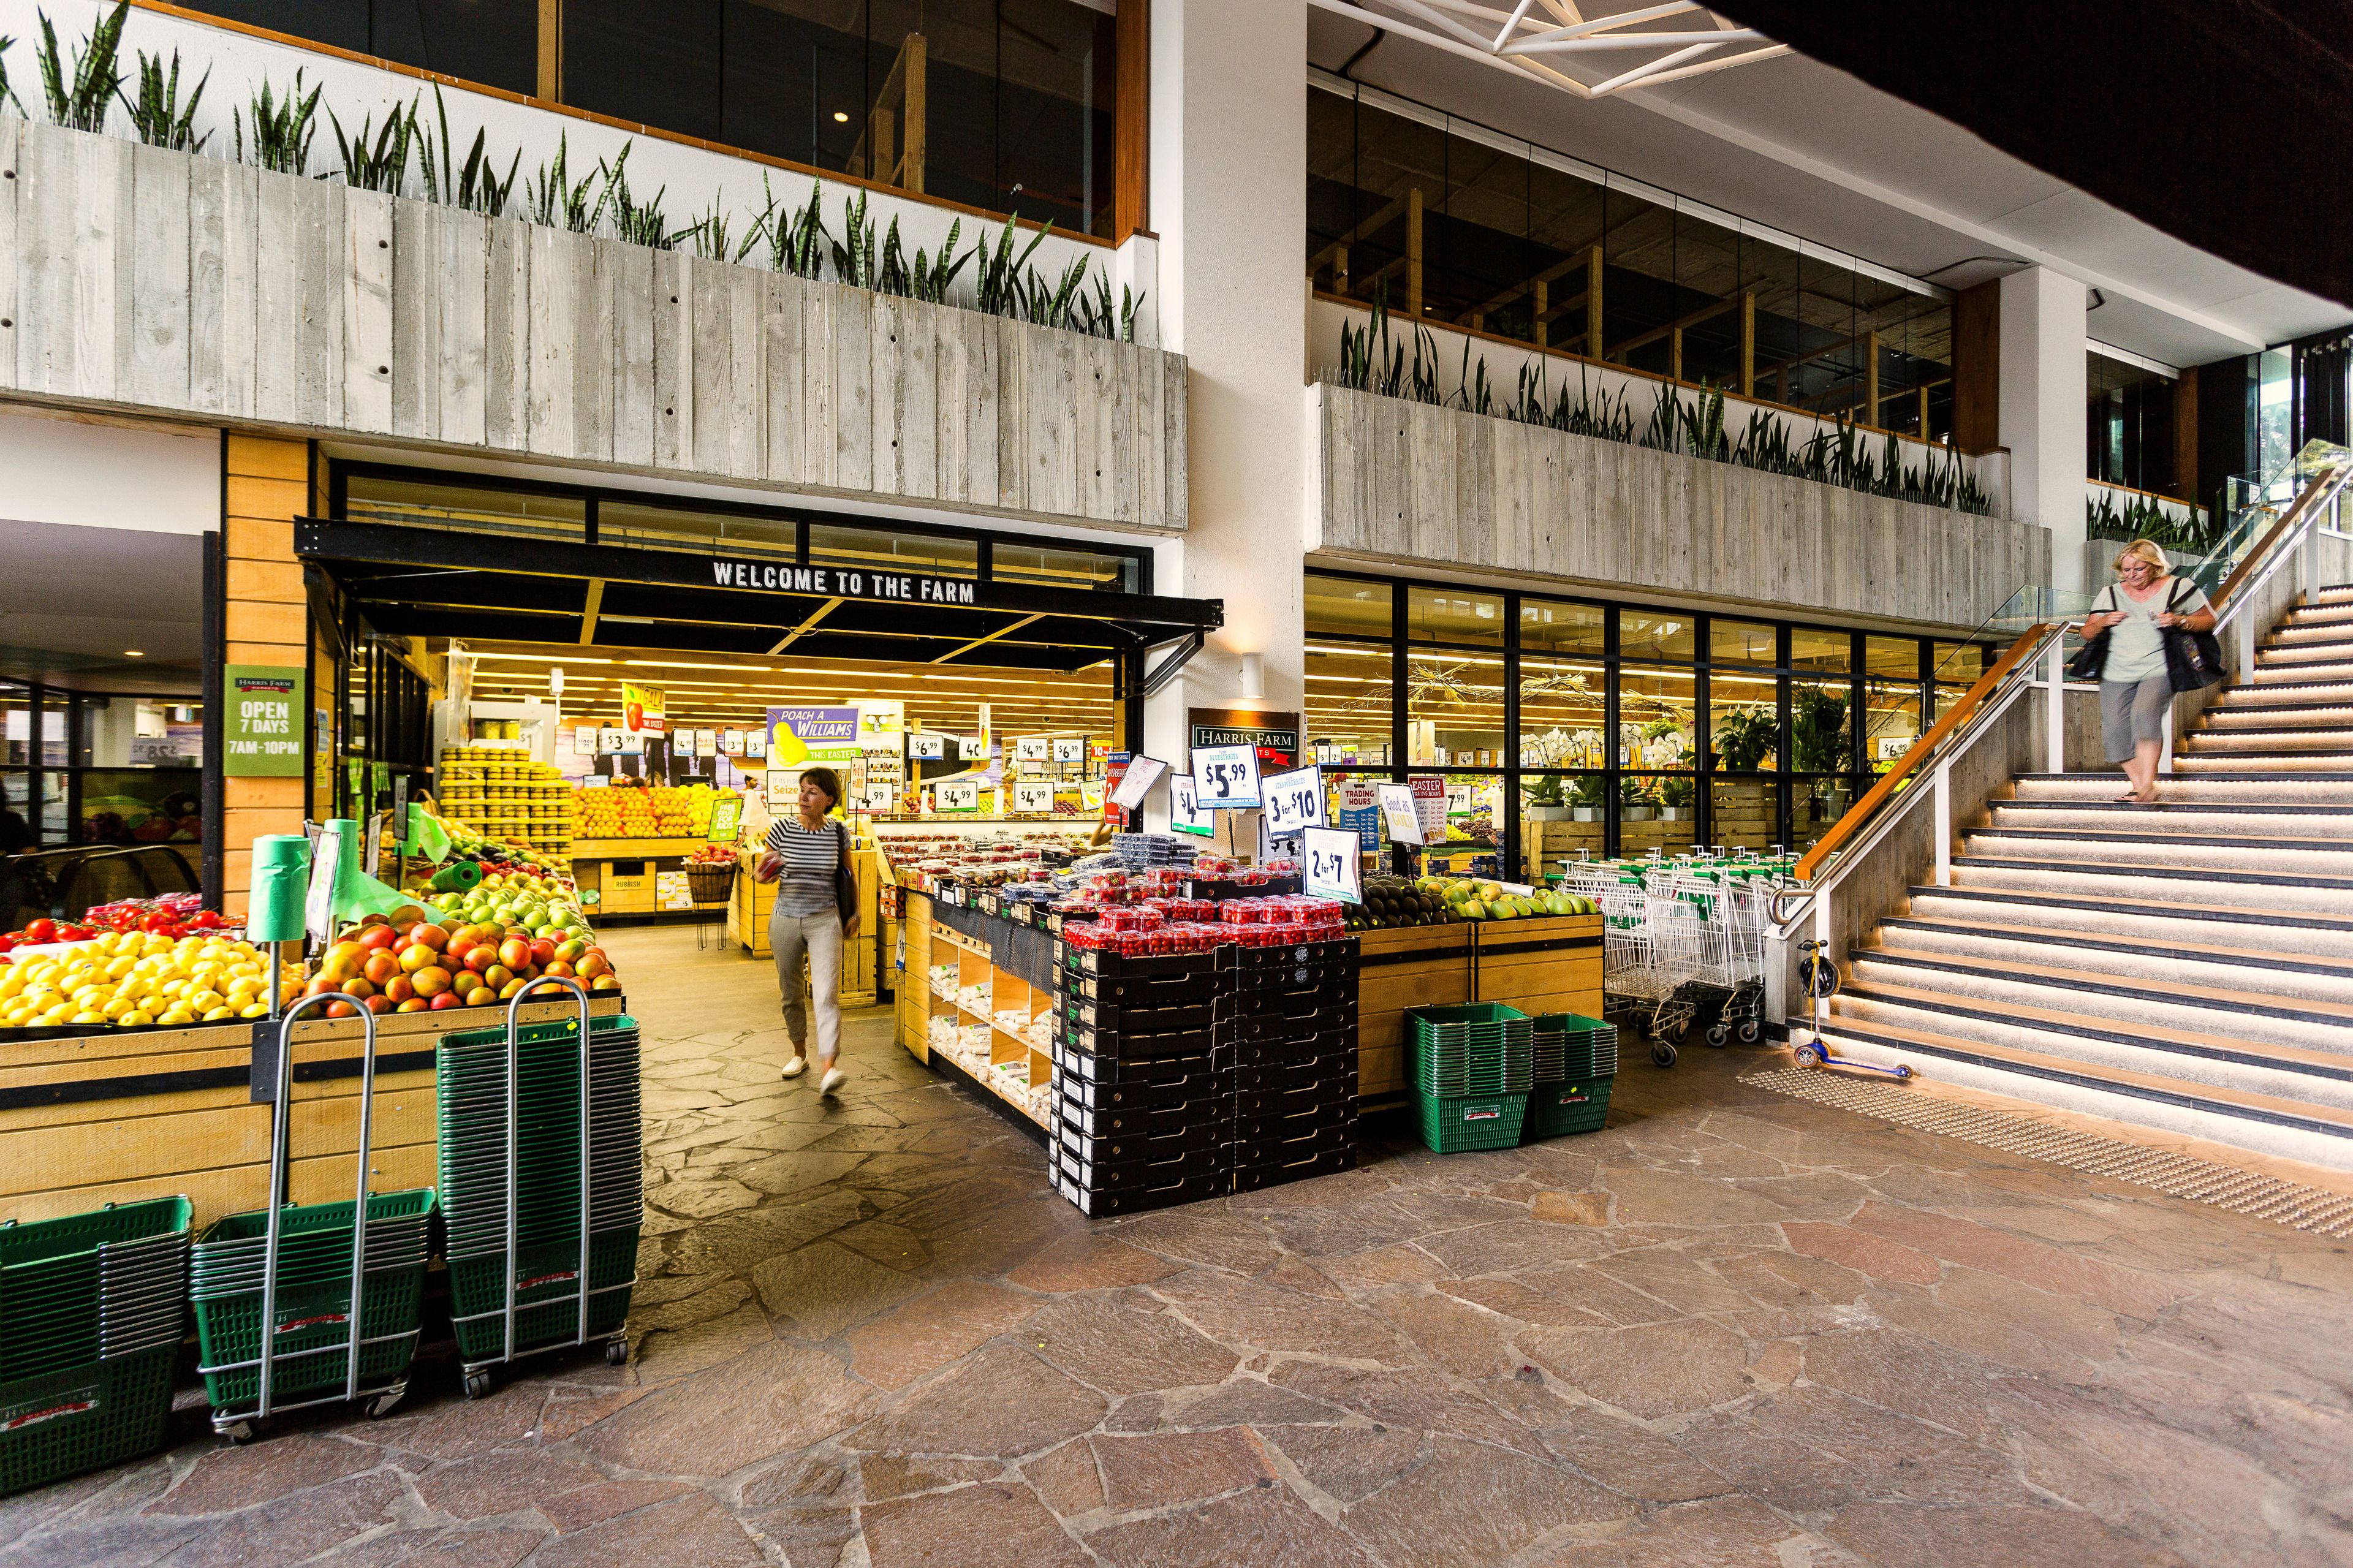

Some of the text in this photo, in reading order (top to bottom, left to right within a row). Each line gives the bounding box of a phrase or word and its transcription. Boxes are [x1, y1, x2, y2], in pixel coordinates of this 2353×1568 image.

[713, 562, 974, 603] WELCOME TO THE FARM
[643, 689, 662, 708] GALA
[241, 701, 289, 719] OPEN
[781, 710, 824, 721] POACH A
[240, 719, 289, 733] 7 DAYS
[798, 721, 853, 737] WILLIAMS
[608, 735, 635, 750] $3.99
[1200, 730, 1292, 746] HARRIS FARM
[229, 740, 299, 754] 7AM-10PM
[809, 749, 856, 759] THIS EASTER
[915, 741, 938, 756] $6.99
[1023, 744, 1042, 757] $4.99
[1059, 746, 1078, 759] $6.99
[1094, 746, 1103, 757] 10
[1885, 744, 1907, 757] $6.99
[1461, 756, 1471, 765] $4.99
[1206, 763, 1246, 798] $5.99
[1275, 778, 1306, 790] STRAWBERRIES
[1412, 780, 1441, 791] EASTER
[774, 785, 798, 794] Seize
[944, 790, 971, 807] $4.99
[1021, 790, 1045, 806] $4.99
[1271, 789, 1315, 822] 3 for $10
[1385, 795, 1410, 812] Good as
[1446, 794, 1464, 811] 7.99
[1313, 850, 1320, 878] 2
[1330, 852, 1343, 883] $7
